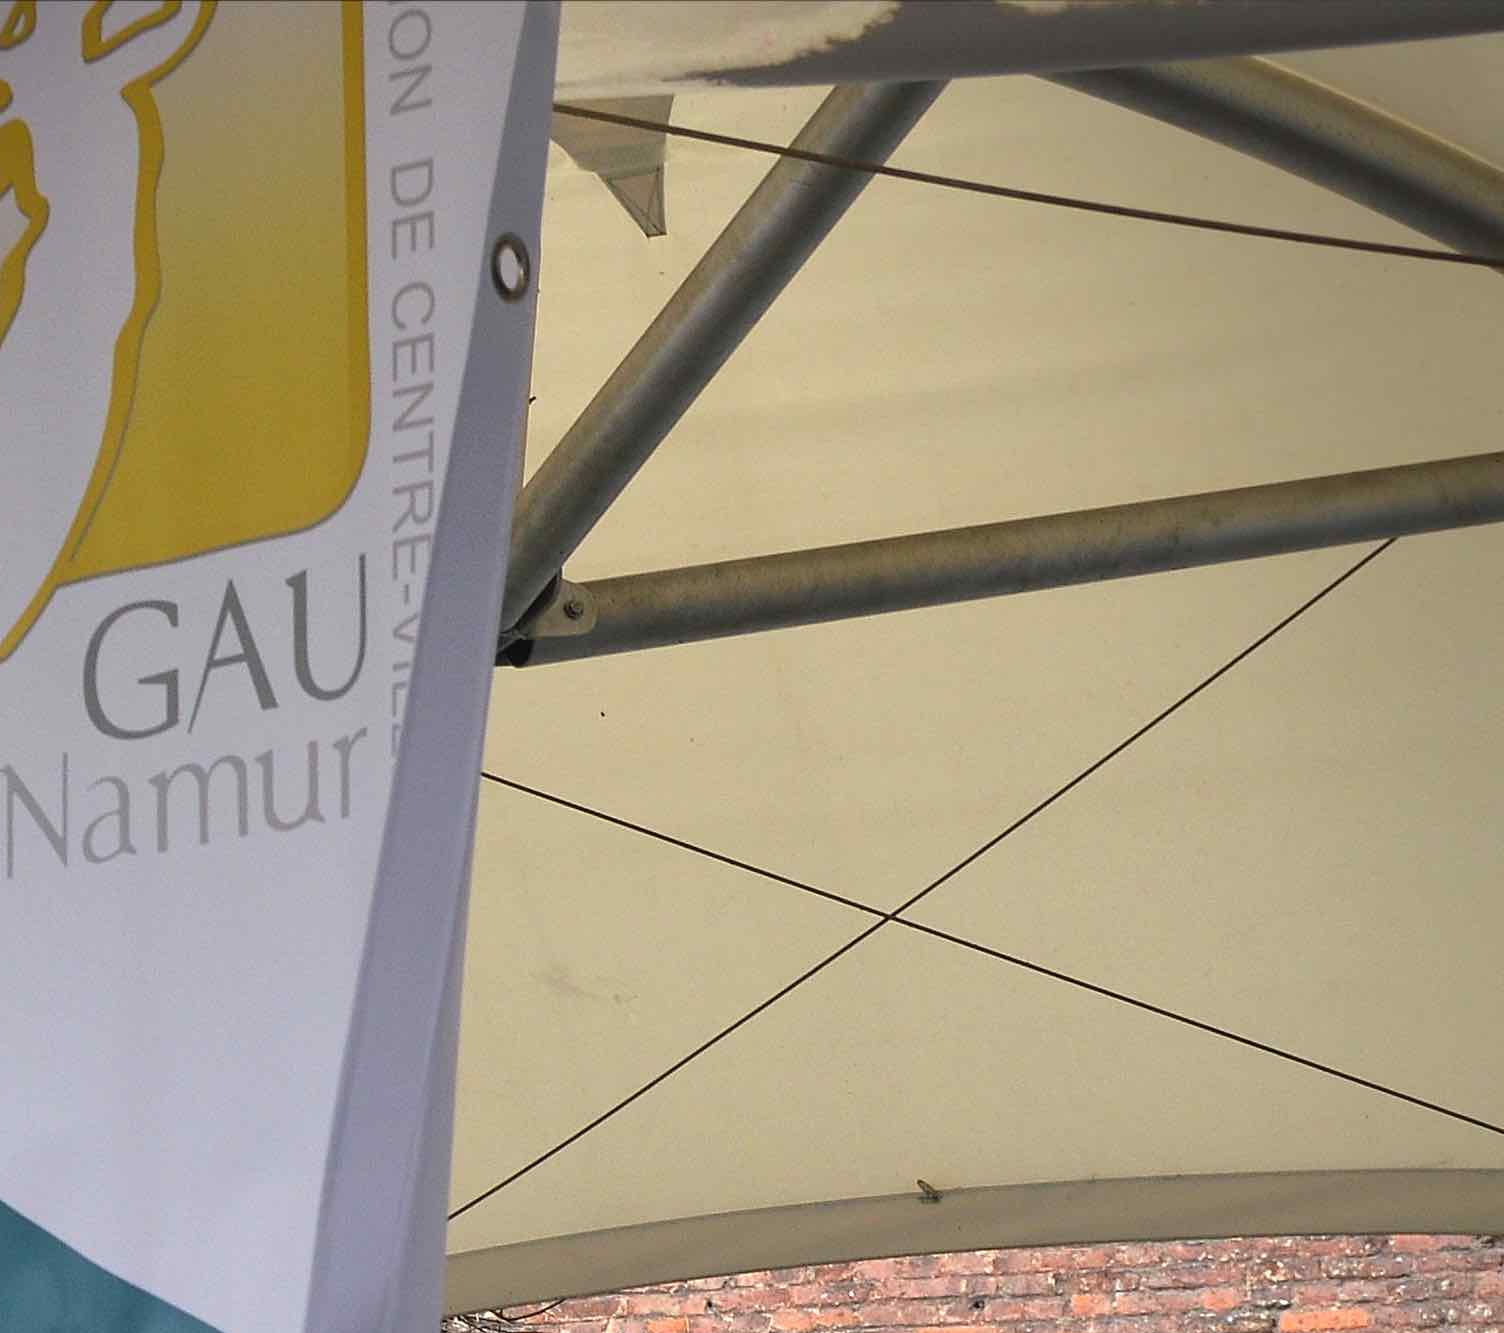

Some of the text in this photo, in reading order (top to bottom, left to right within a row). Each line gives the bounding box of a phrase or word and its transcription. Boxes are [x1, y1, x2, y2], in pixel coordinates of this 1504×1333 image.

[388, 0, 432, 116] ON
[390, 158, 435, 259] DE
[81, 553, 367, 740] GAU
[0, 727, 368, 880] Namur
